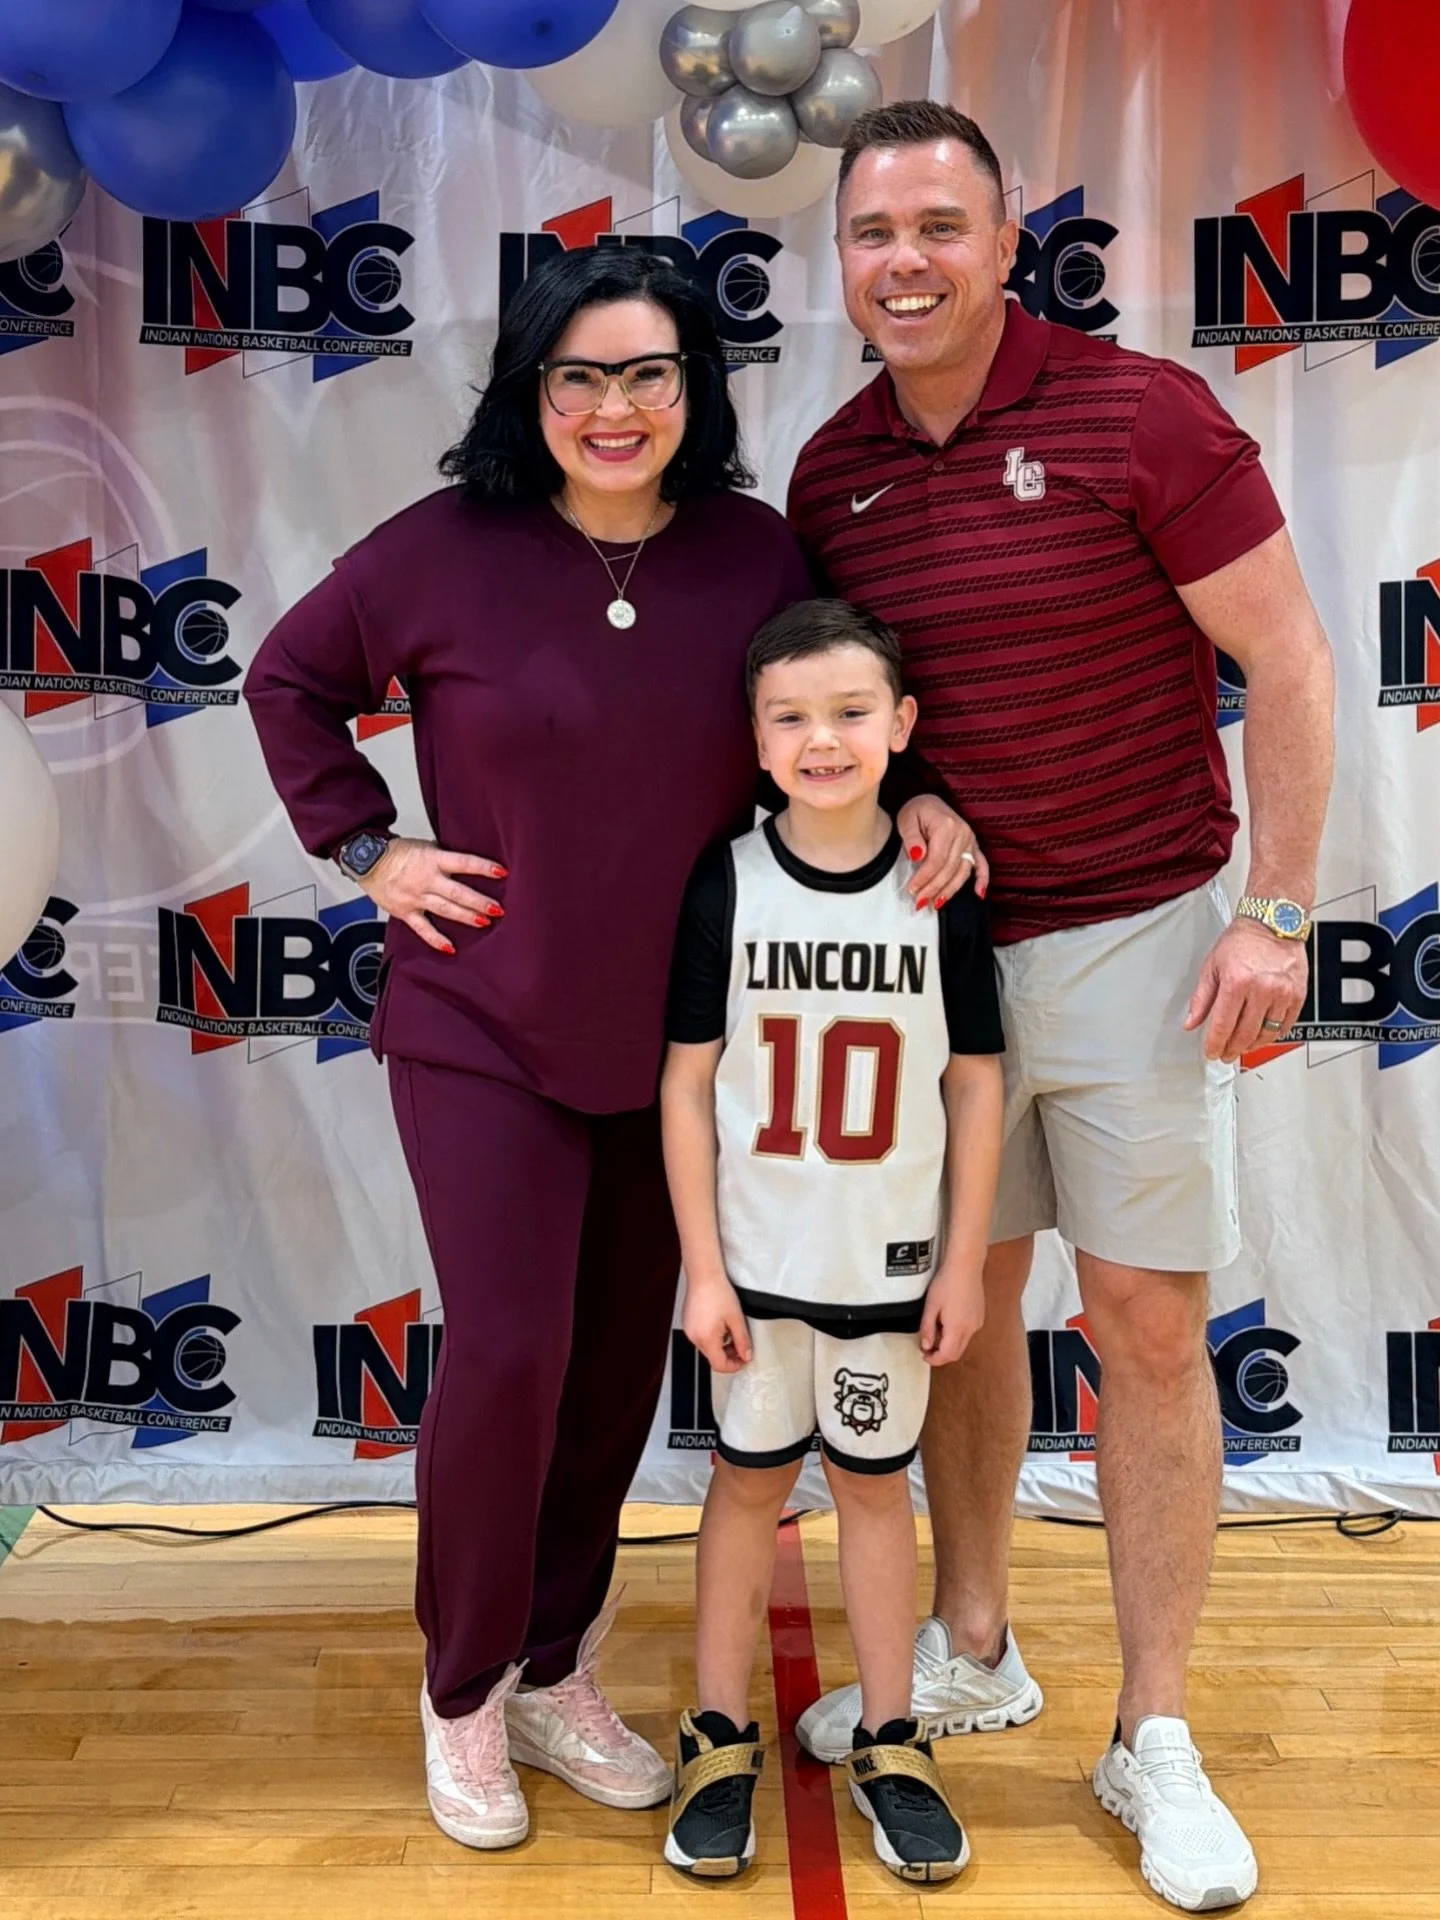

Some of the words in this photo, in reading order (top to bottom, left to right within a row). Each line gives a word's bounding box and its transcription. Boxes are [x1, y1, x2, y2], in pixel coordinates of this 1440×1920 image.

[143, 216, 415, 336] INBC
[0, 320, 72, 335] ONFERENCE
[1196, 330, 1241, 345] INDIAN
[1245, 328, 1300, 342] NATIONS
[1304, 325, 1381, 340] BASKETBALL
[1384, 322, 1440, 336] CONFERE
[145, 328, 191, 343] INDIAN
[194, 332, 239, 347] NATIONS
[242, 335, 320, 351] BASKETBALL
[323, 339, 408, 354] CONFERENCE
[0, 674, 31, 688] DIAN
[34, 676, 91, 690] NATIONS
[93, 680, 149, 699] BASKETBALL
[151, 689, 234, 704] CONFERENCE
[1383, 689, 1422, 704] INDIAN
[744, 941, 927, 995] LINCOLN
[0, 999, 71, 1016] ONFERENCE
[161, 1008, 195, 1029] INDIAN
[196, 1018, 244, 1034] NATIONS
[247, 1022, 324, 1035] BASKETBALL
[1306, 1026, 1385, 1041] BASKETBALL
[751, 1013, 905, 1165] 10
[0, 1299, 242, 1413] NBC
[14, 1405, 68, 1418] NATIONS
[70, 1404, 144, 1424] BASKETBALL
[147, 1413, 226, 1430] CONFERENCE
[318, 1422, 361, 1437] INDIAN
[363, 1428, 416, 1443] NATIONS
[672, 1435, 717, 1448] INDIAN
[1031, 1436, 1075, 1450] INDIAN
[1223, 1438, 1297, 1451] ONFERENCE
[1392, 1438, 1438, 1450] INDIAN
